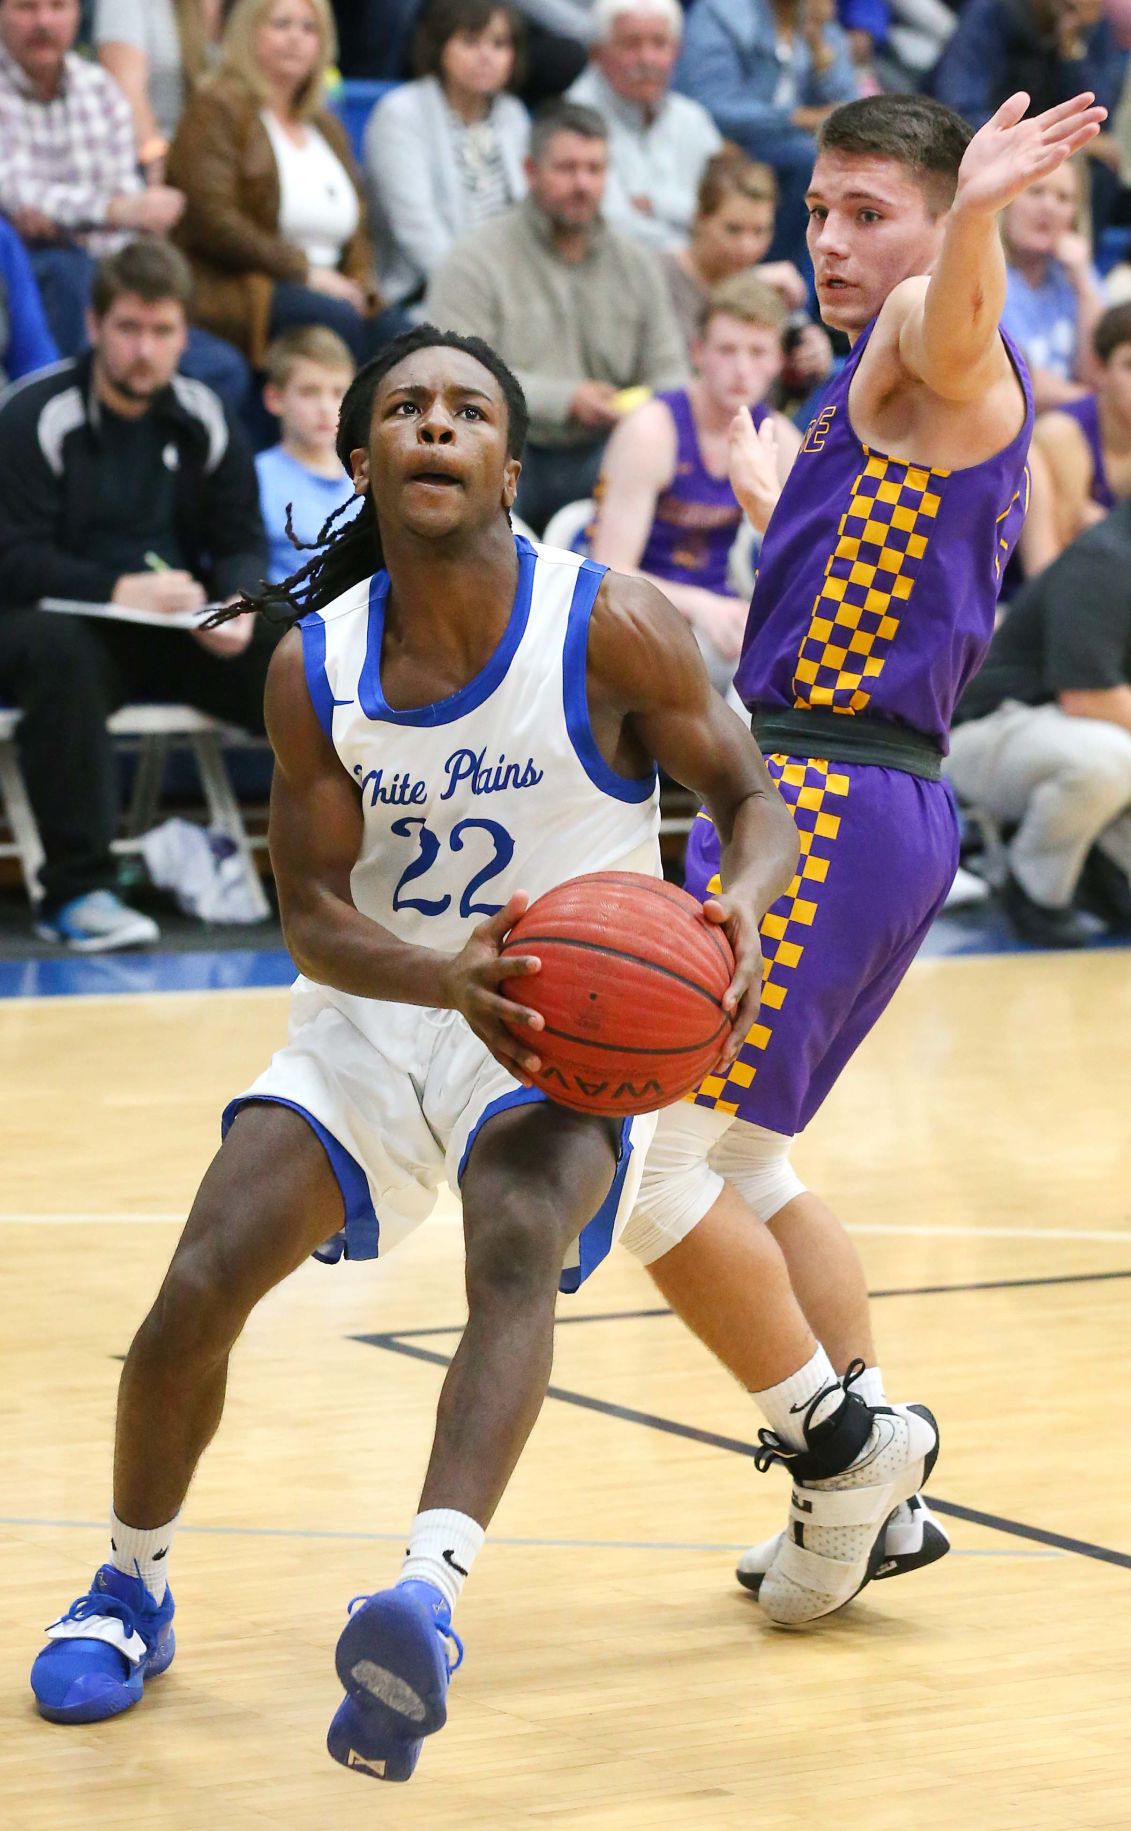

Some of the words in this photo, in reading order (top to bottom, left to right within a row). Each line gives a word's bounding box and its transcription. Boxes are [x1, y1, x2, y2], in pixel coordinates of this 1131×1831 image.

[799, 405, 837, 454] E
[440, 746, 544, 800] Plains
[391, 816, 516, 918] 22
